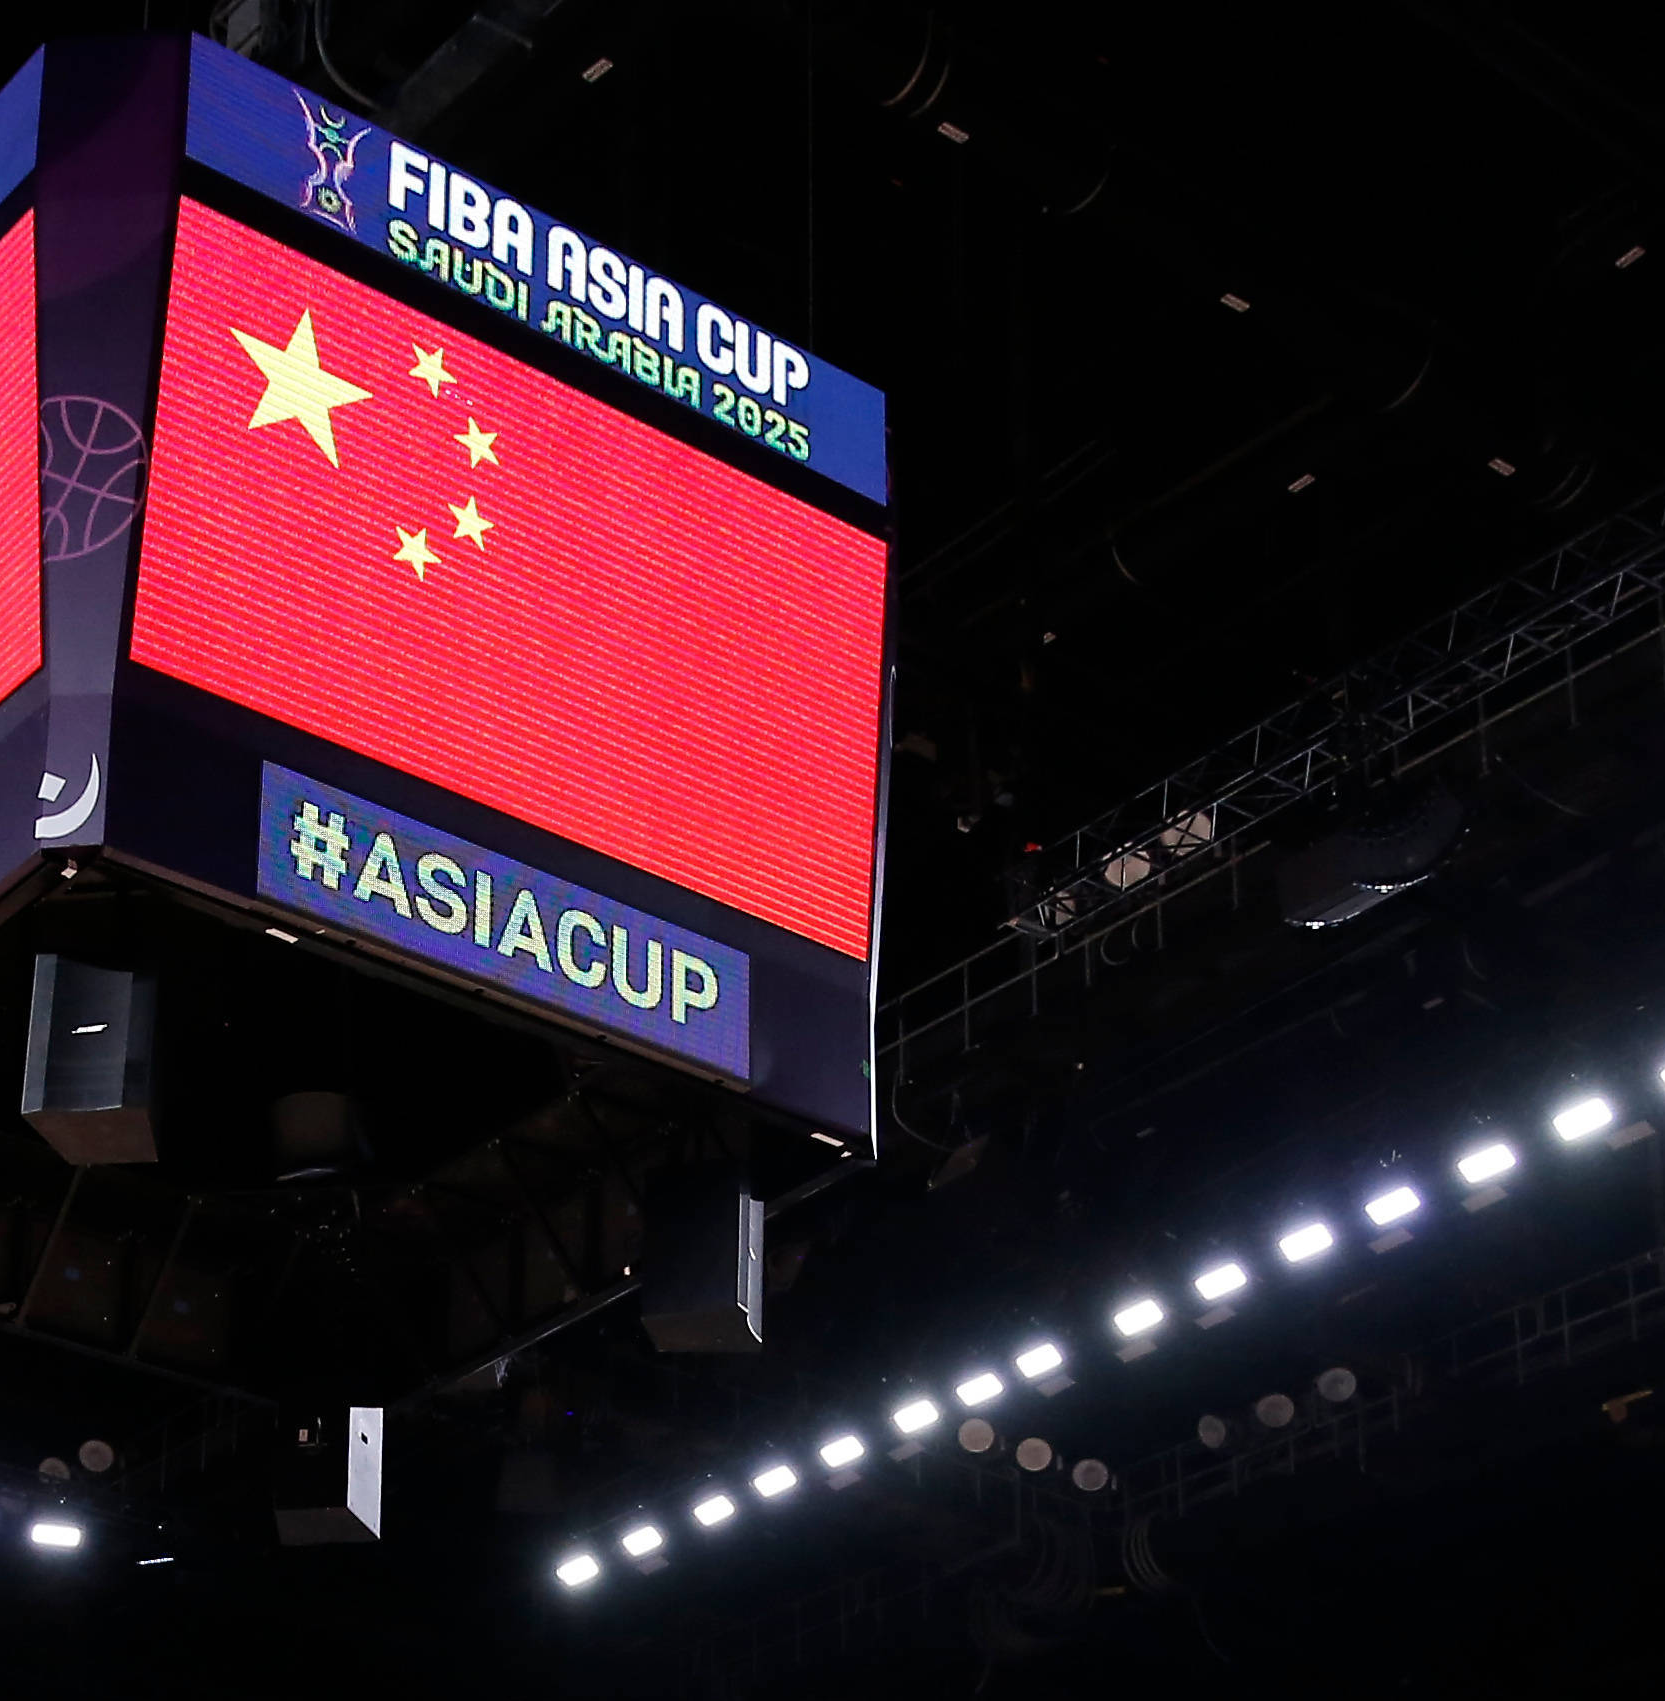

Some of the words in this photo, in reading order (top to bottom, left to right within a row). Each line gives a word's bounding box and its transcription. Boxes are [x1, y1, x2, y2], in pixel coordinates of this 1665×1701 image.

[387, 219, 529, 321] SAUDI
[540, 300, 701, 409] ARABIA
[712, 382, 810, 462] 2025
[388, 140, 534, 276] FIBA
[547, 224, 685, 353] ASIA
[695, 302, 810, 407] CUP
[288, 798, 720, 1025] #ASIACUP
